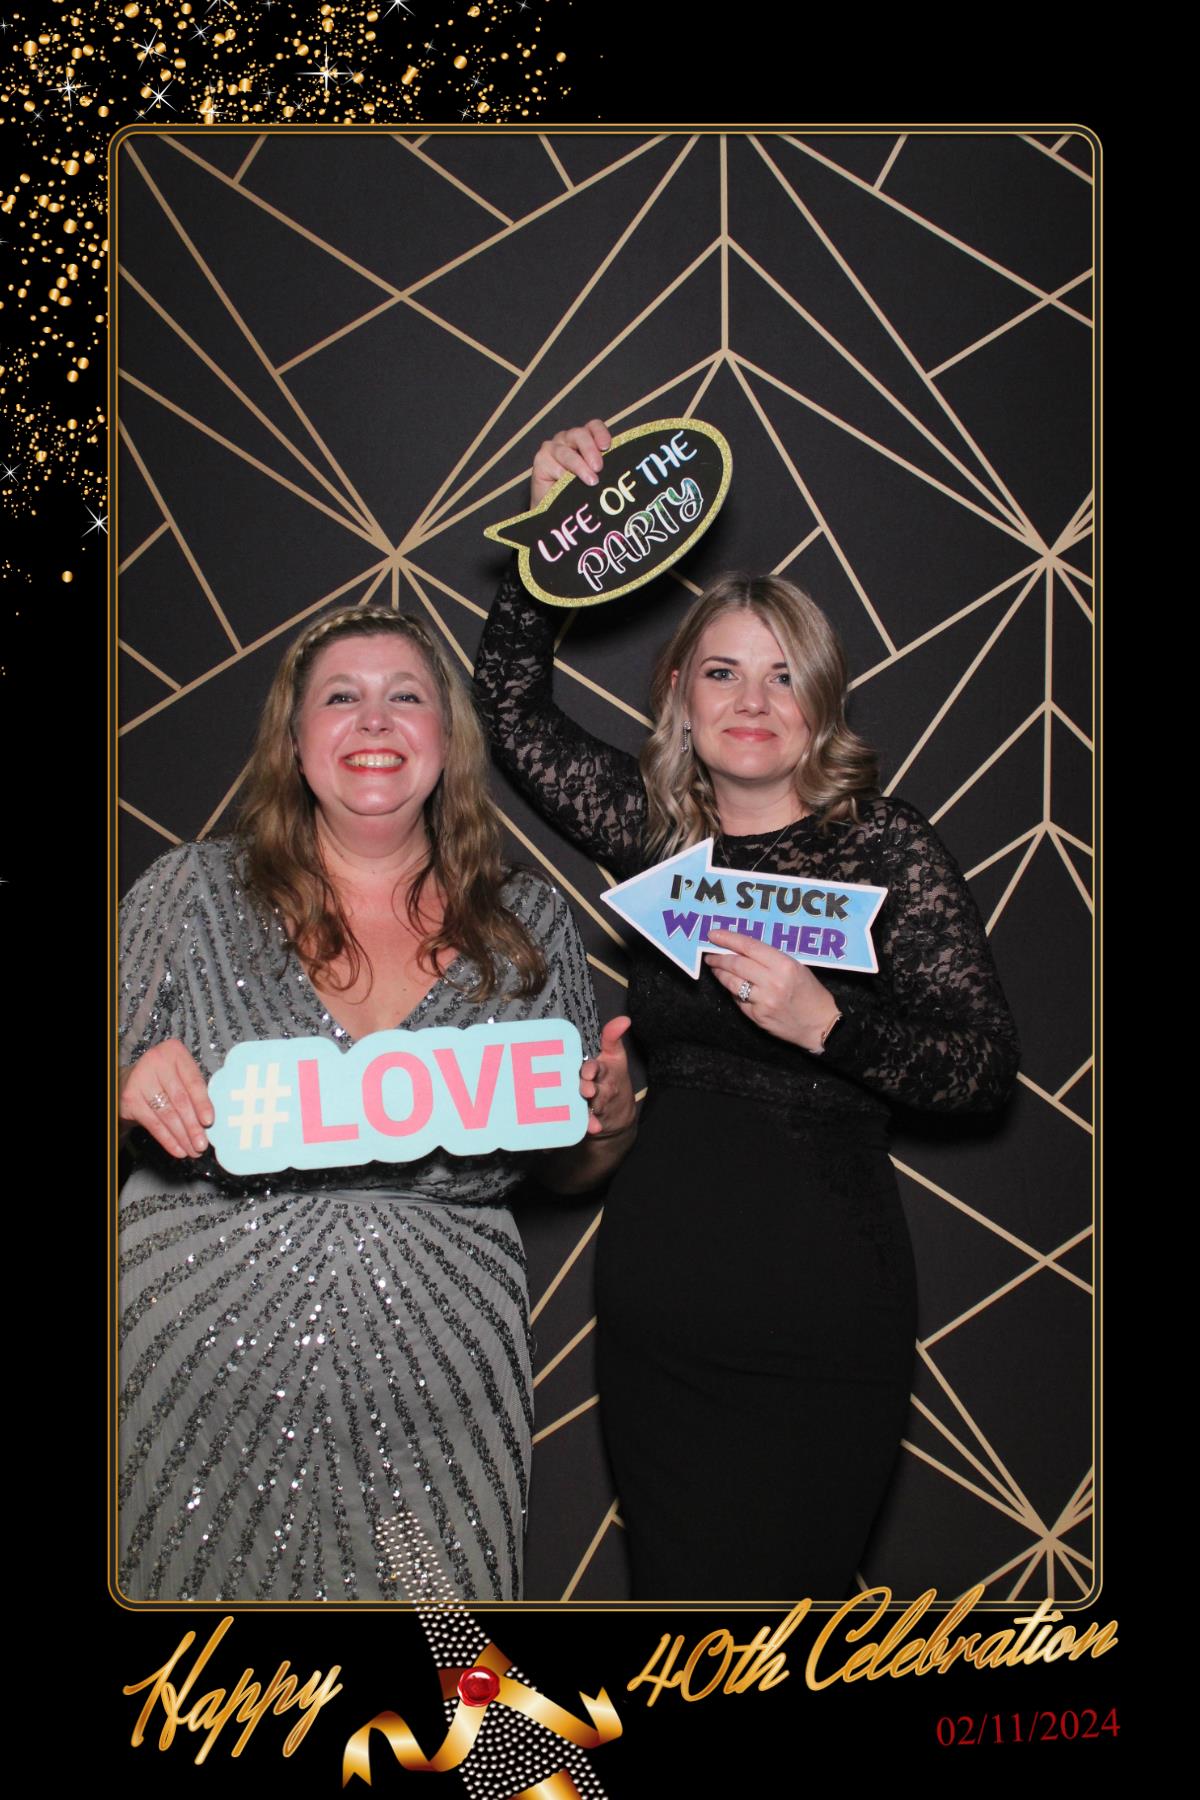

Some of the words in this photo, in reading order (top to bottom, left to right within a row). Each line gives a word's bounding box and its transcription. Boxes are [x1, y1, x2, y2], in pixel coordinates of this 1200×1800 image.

[538, 504, 601, 562] LIFE
[600, 470, 636, 515] OF
[636, 430, 697, 485] THE
[577, 478, 704, 592] PARTY
[670, 874, 726, 904] I'M
[735, 881, 850, 920] STUCK
[771, 922, 848, 960] HER
[227, 1039, 571, 1151] #LOVE
